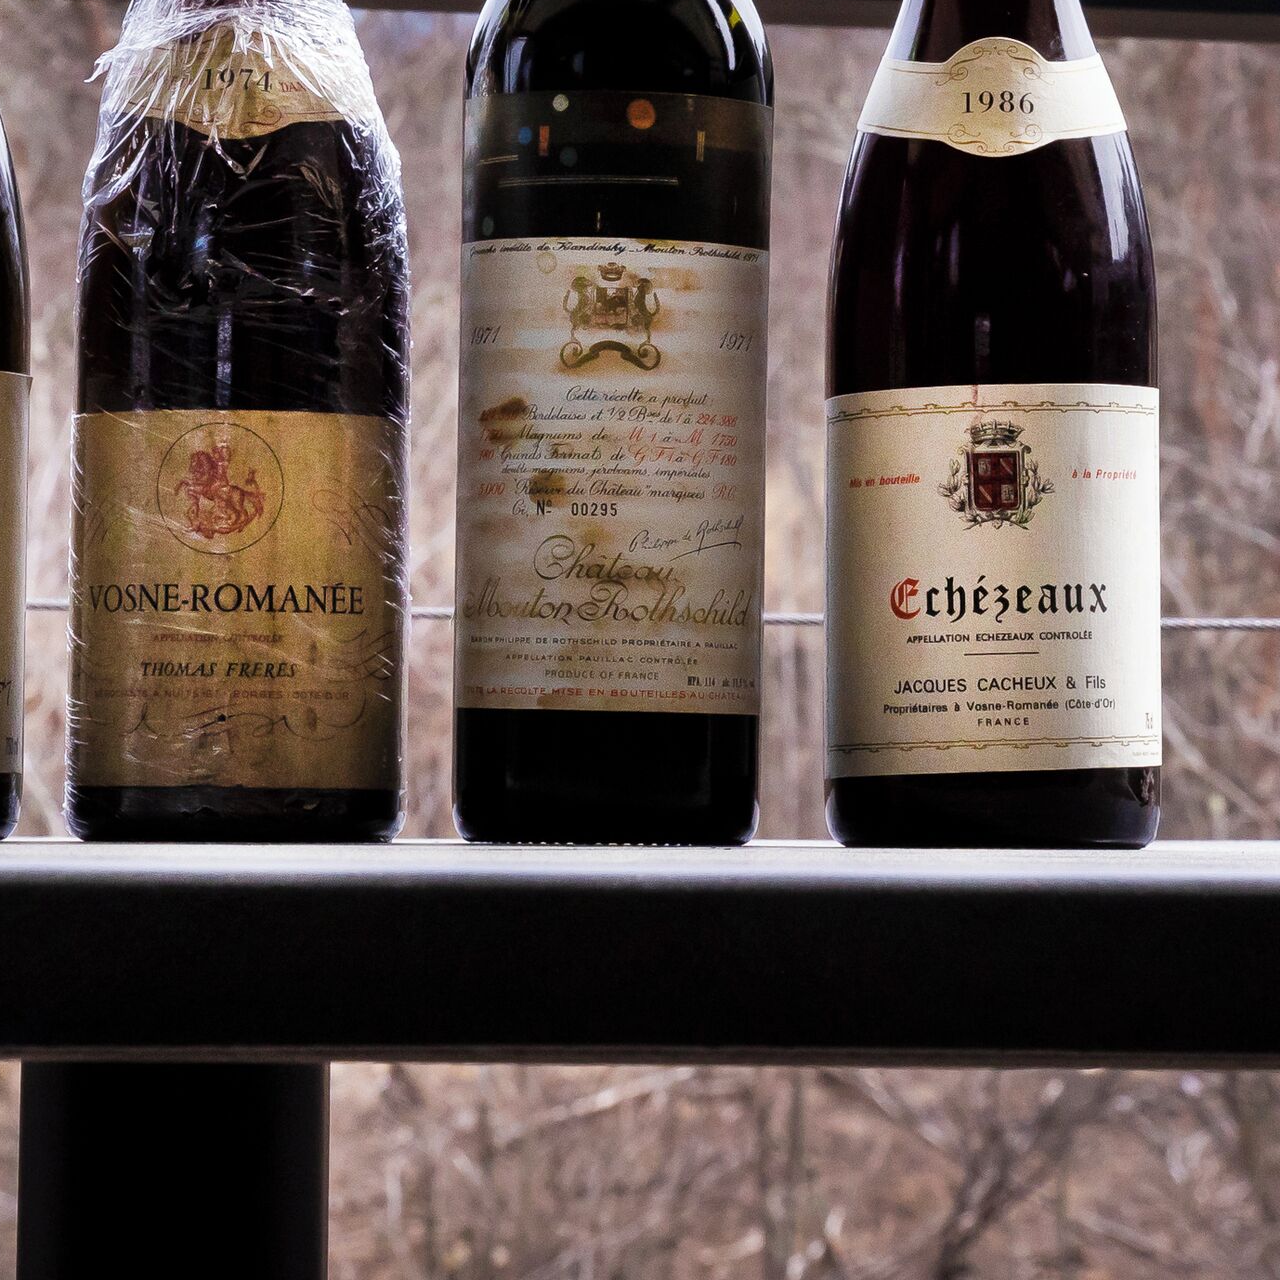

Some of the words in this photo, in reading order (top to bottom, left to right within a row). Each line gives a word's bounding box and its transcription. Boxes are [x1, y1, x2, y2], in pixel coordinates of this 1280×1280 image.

[961, 90, 1035, 114] 1986
[537, 242, 550, 251] de
[552, 240, 626, 256] Kandinsky
[636, 243, 686, 255] Mouton
[688, 246, 741, 260] Rothschild
[470, 325, 501, 346] 1971
[719, 331, 753, 352] 1971
[865, 479, 875, 487] en
[879, 473, 920, 487] bouteille
[1082, 469, 1091, 479] la
[1096, 469, 1137, 481] Propriété
[571, 503, 618, 517] 00295
[89, 582, 366, 615] VOSNE-ROMANÉE
[576, 579, 753, 626] Rothschild
[890, 574, 1108, 624] Echézeaux
[495, 636, 531, 644] PHILIPPE
[553, 638, 618, 646] ROTHSCHILD
[906, 633, 971, 644] APPELLATION
[976, 632, 1034, 643] ECHEZEAUX
[505, 654, 573, 662] APPELLATION
[579, 655, 634, 664] PAUILLAC
[140, 662, 218, 677] THOMAS
[544, 670, 596, 680] PRODUCE
[599, 672, 615, 680] OF
[619, 672, 660, 681] FRANCE
[894, 678, 967, 695] JACQUES
[977, 676, 1057, 692] CACHEUX
[1066, 676, 1076, 690] &
[1085, 675, 1106, 690] Fils
[552, 687, 584, 697] MISE
[588, 687, 605, 697] EN
[610, 689, 687, 700] BOUTEILLES
[689, 690, 705, 700] AU
[883, 701, 948, 716] Propriétaires
[954, 701, 960, 713] à
[966, 699, 1059, 712] Vosne-Romanée
[977, 717, 1030, 727] FRANCE
